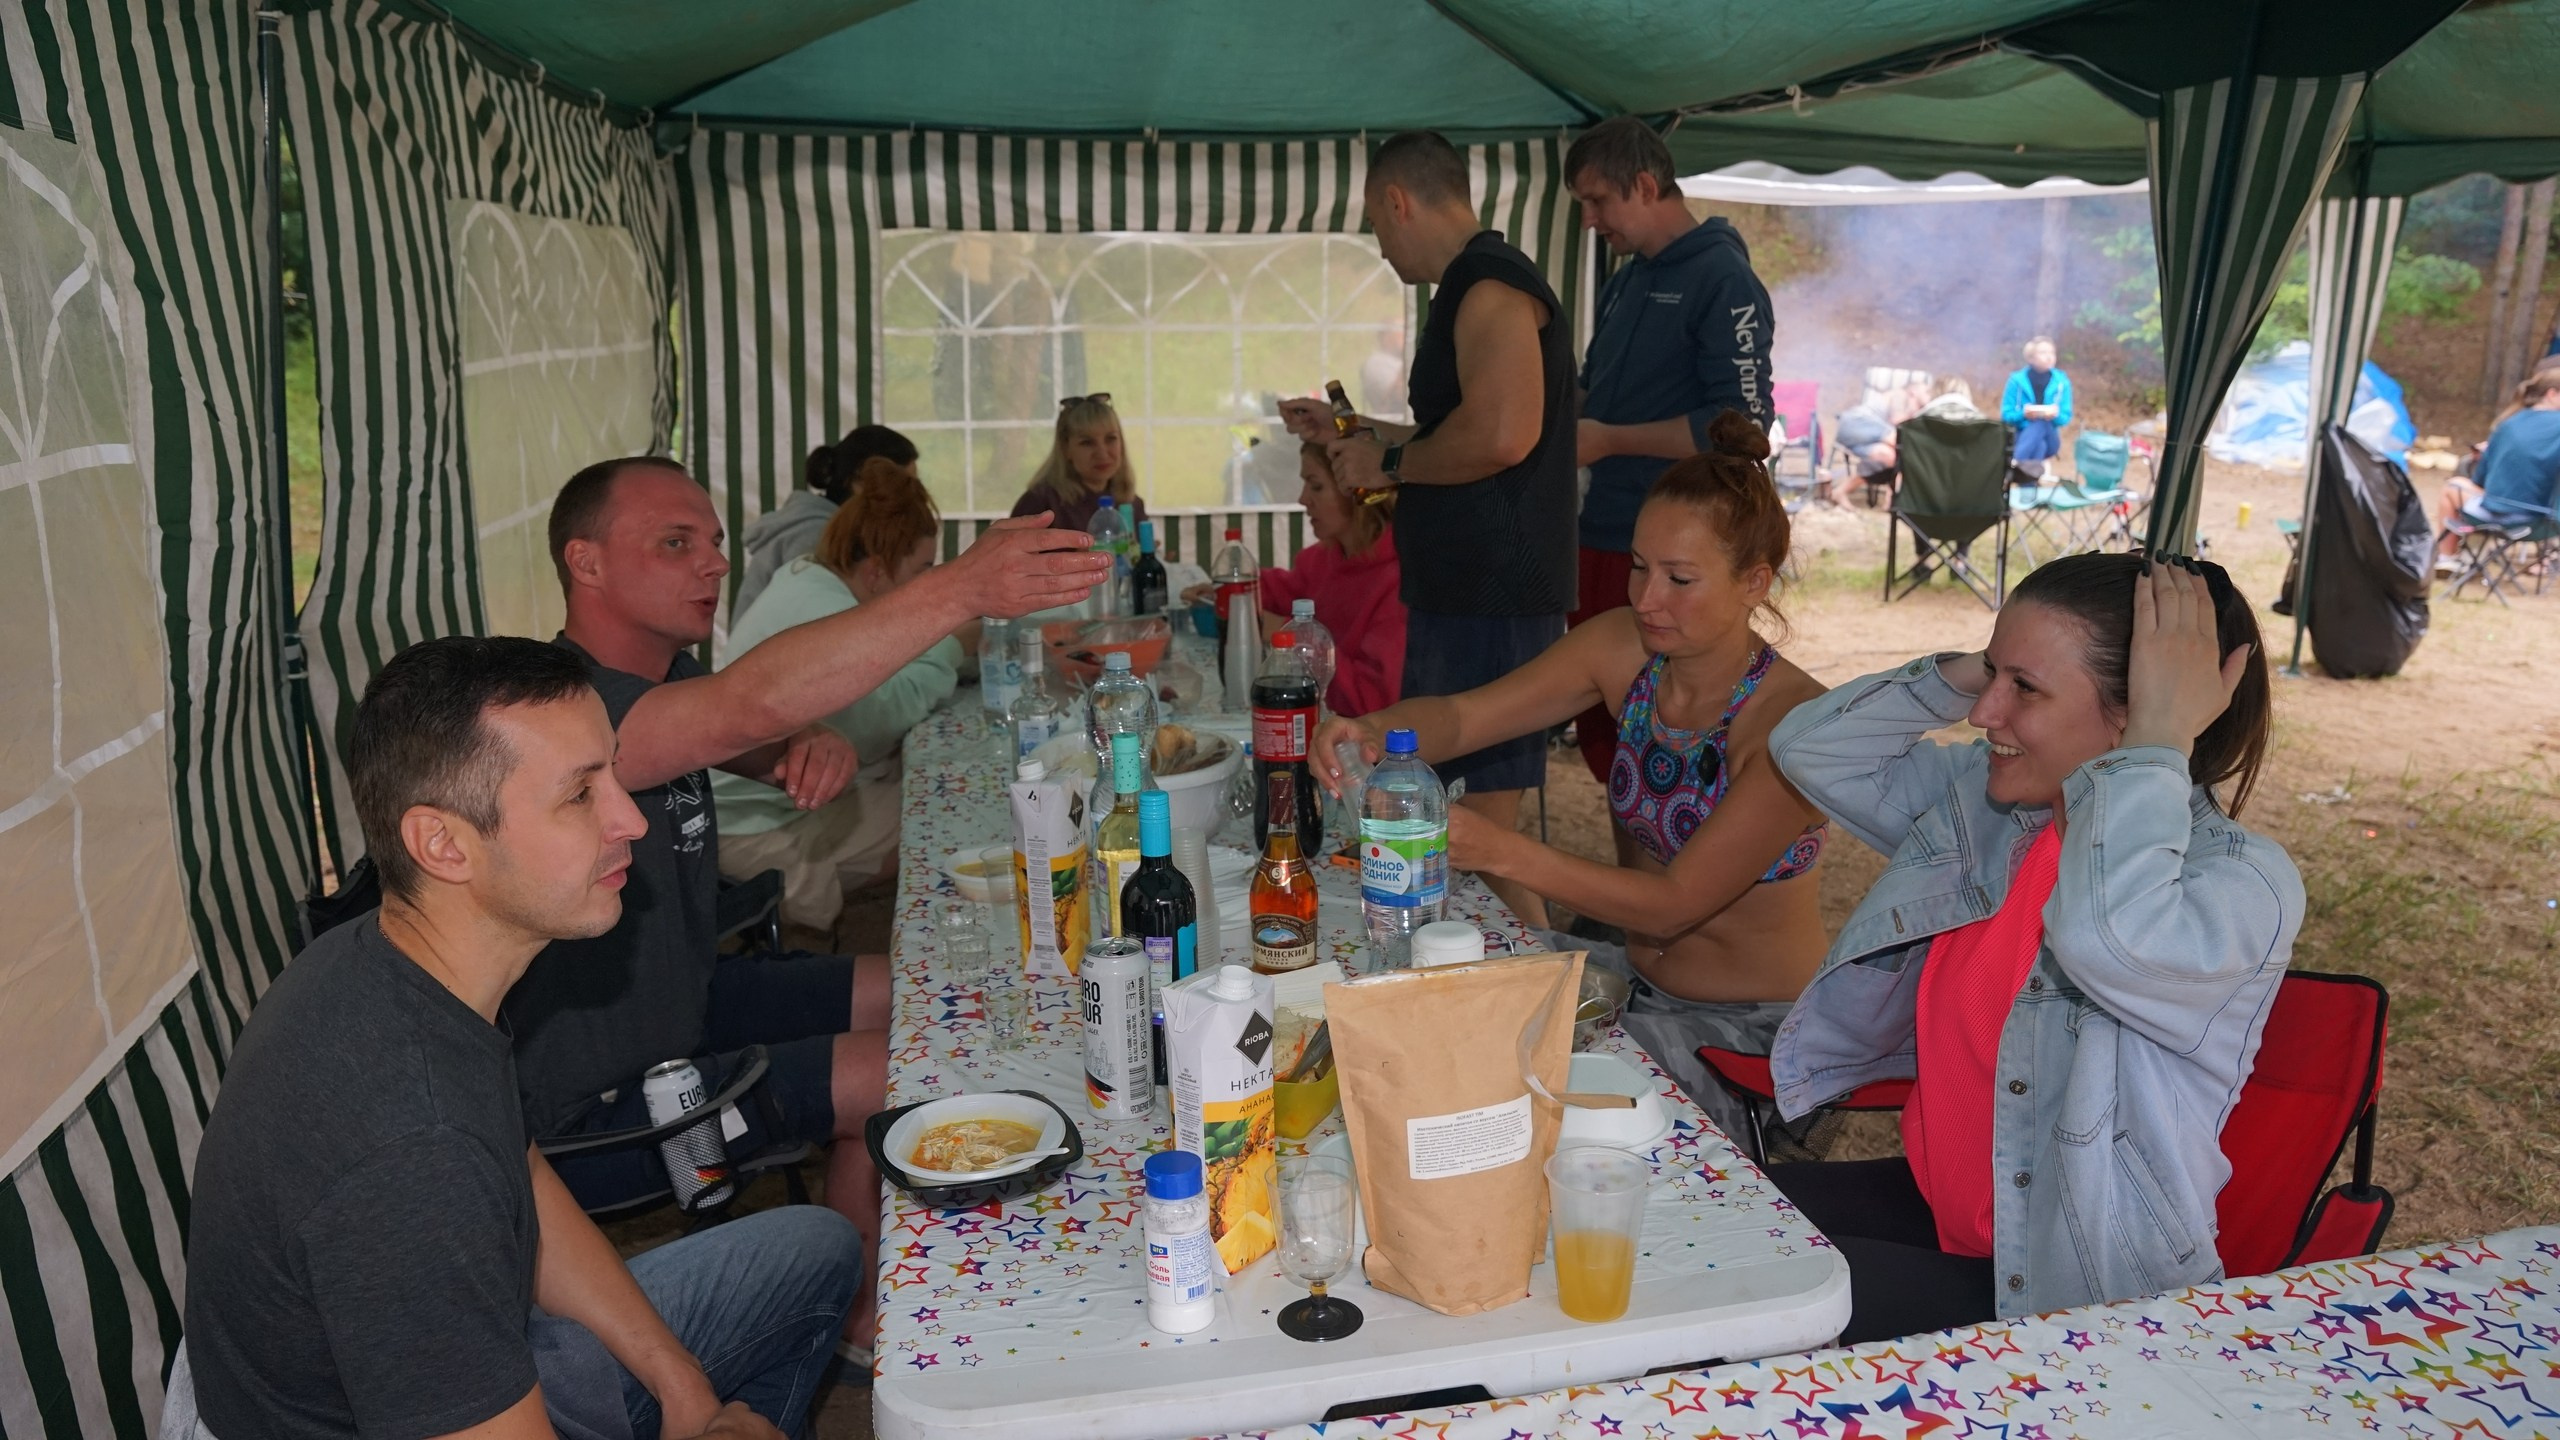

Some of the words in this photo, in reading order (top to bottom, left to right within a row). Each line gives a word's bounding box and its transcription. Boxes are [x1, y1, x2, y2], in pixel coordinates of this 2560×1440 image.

[1274, 868, 1280, 878] 5
[1244, 1030, 1270, 1047] RIOBA
[1149, 1260, 1170, 1273] Соль
